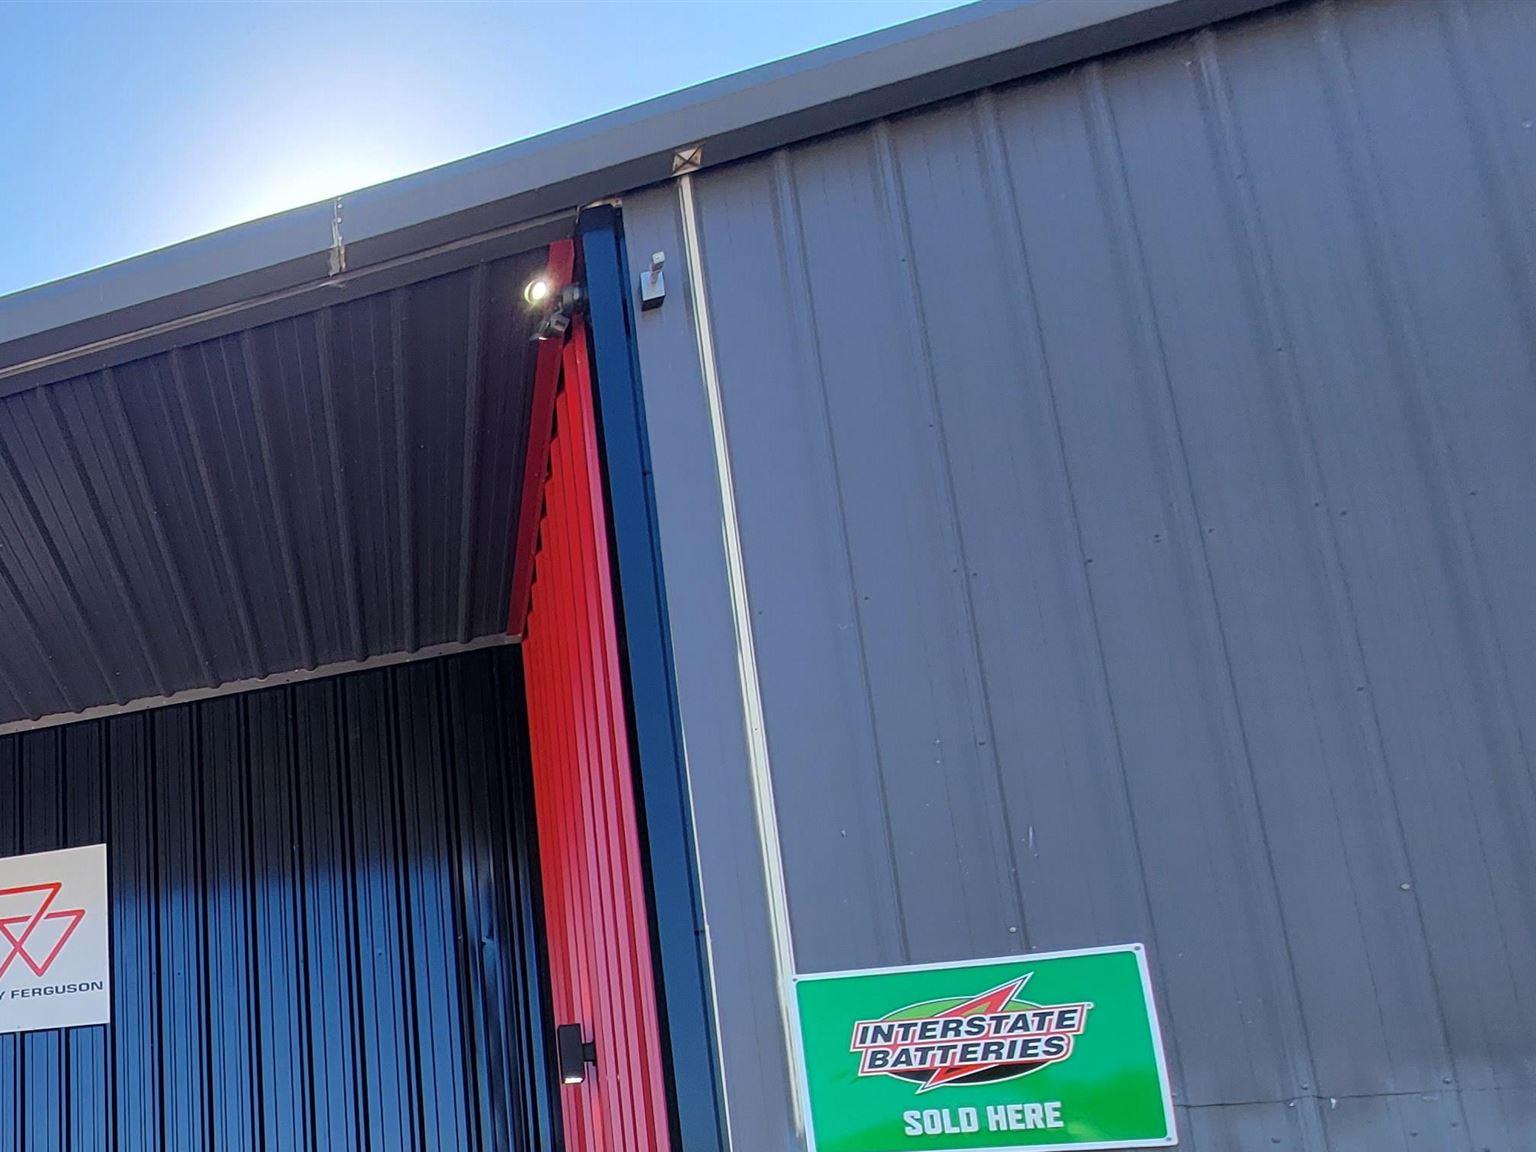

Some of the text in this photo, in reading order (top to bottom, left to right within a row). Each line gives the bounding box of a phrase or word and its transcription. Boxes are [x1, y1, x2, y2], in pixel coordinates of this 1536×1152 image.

[10, 981, 104, 1000] FERGUSON
[858, 1007, 1078, 1046] INTERSTATE
[867, 1035, 1067, 1070] BATTERIES
[902, 1101, 1065, 1137] SOLD HERE
